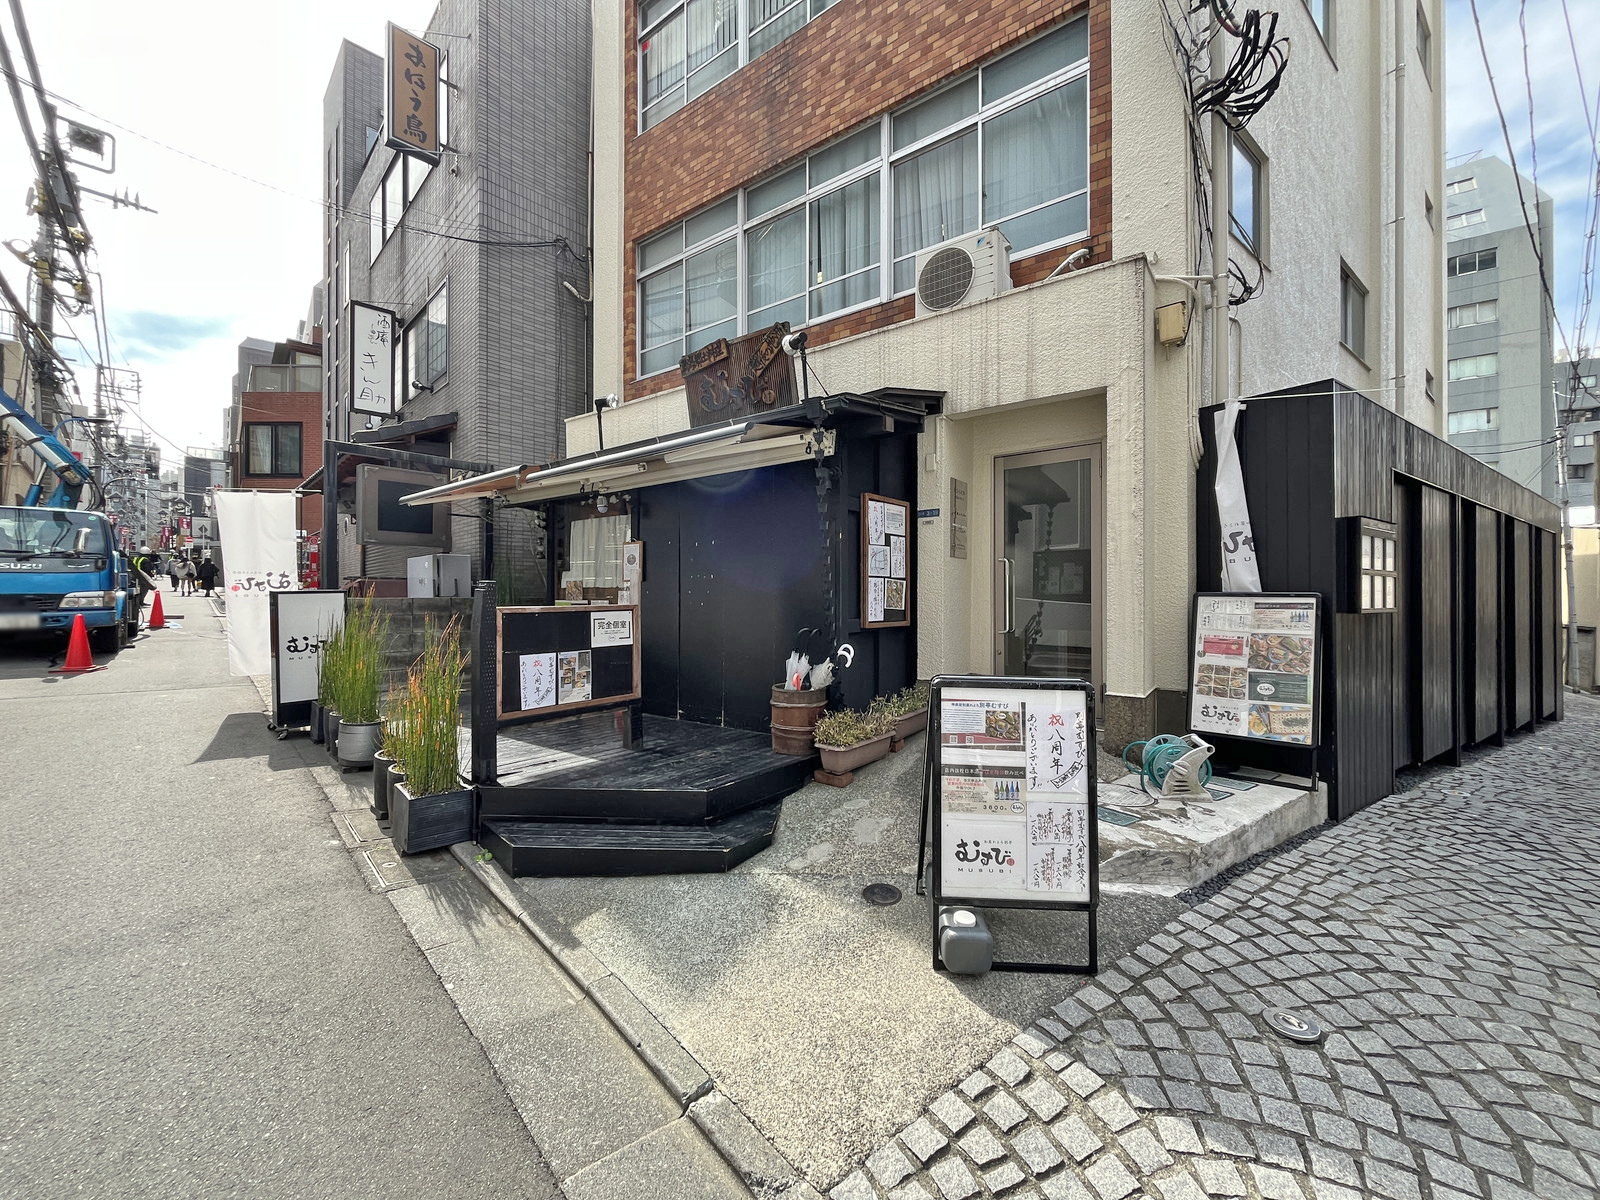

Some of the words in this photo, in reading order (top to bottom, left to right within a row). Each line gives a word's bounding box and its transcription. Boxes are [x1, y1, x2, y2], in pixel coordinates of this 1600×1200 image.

[597, 620, 627, 630] 完全個室
[1047, 713, 1066, 775] 祝八周年
[955, 838, 1012, 867] むすび
